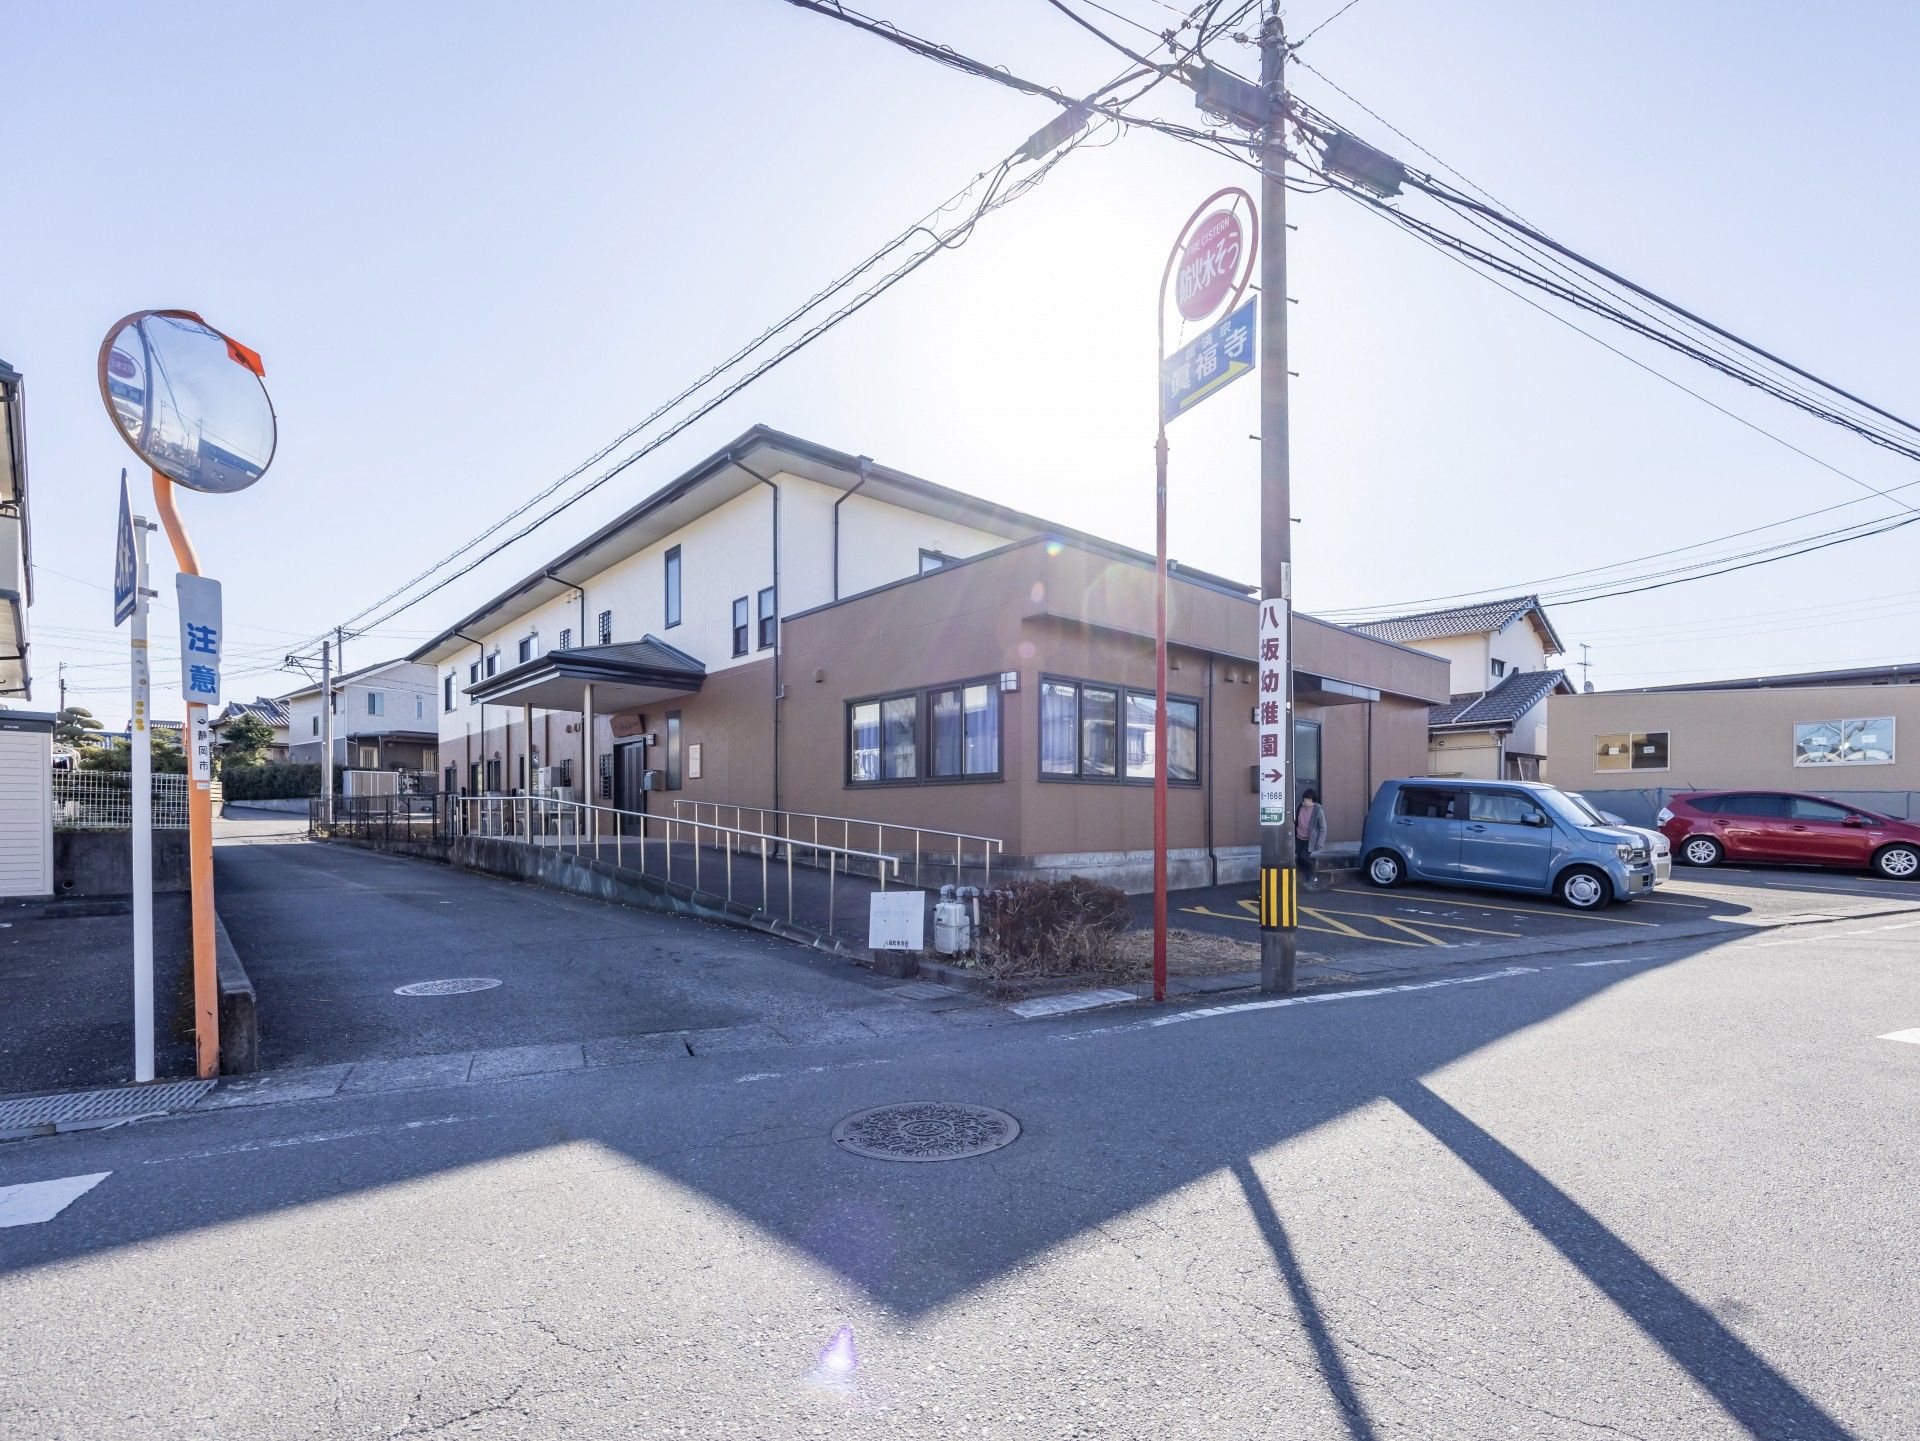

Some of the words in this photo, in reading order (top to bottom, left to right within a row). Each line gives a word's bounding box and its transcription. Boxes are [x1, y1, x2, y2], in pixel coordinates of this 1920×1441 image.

[1180, 232, 1238, 303] 防火水そう
[1201, 217, 1230, 247] CISTERN
[186, 622, 217, 694] 注意
[1261, 605, 1280, 758] 八坂幼稚園
